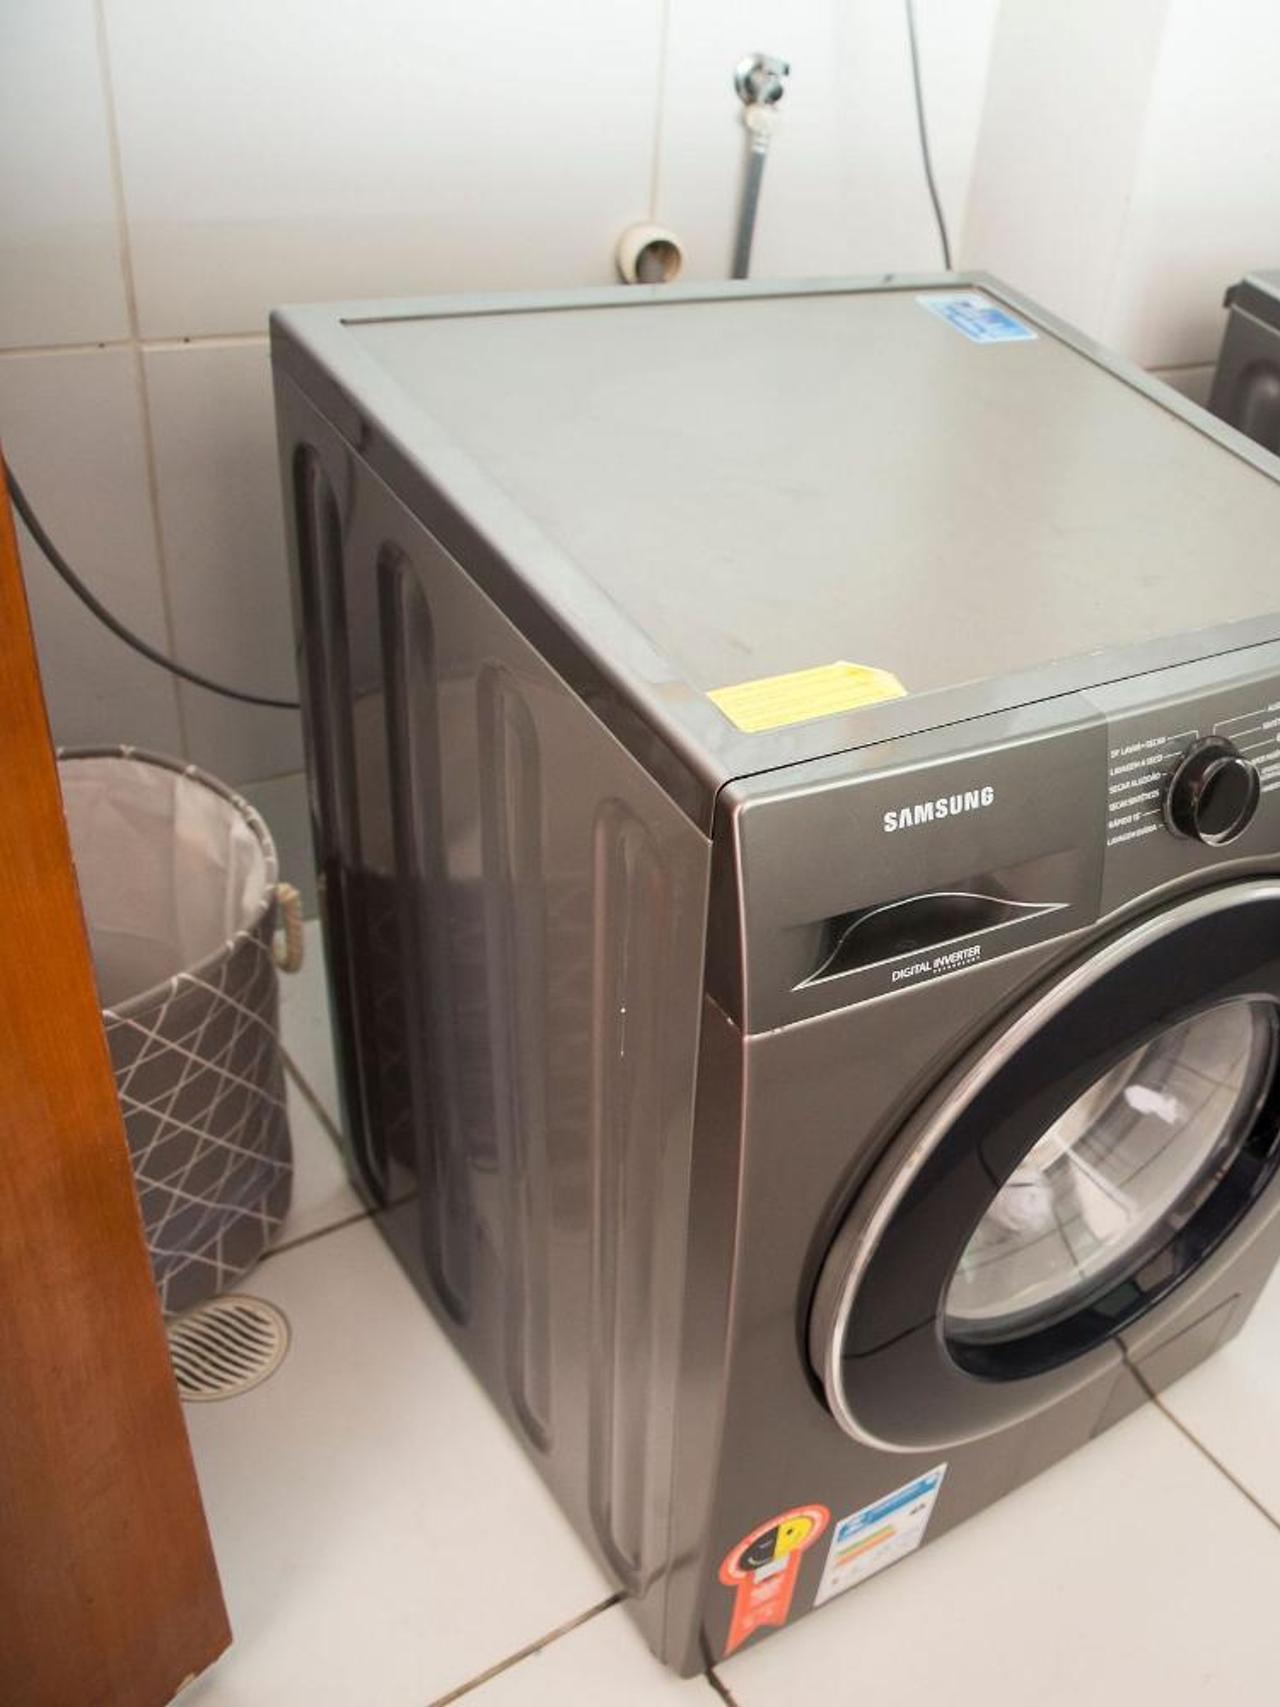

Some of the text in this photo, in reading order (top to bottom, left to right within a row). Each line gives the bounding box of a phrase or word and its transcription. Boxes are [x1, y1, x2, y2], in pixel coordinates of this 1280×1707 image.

[883, 786, 994, 832] SAMSUNG
[892, 961, 932, 983] DIGITAL
[933, 945, 980, 969] INVERTER
